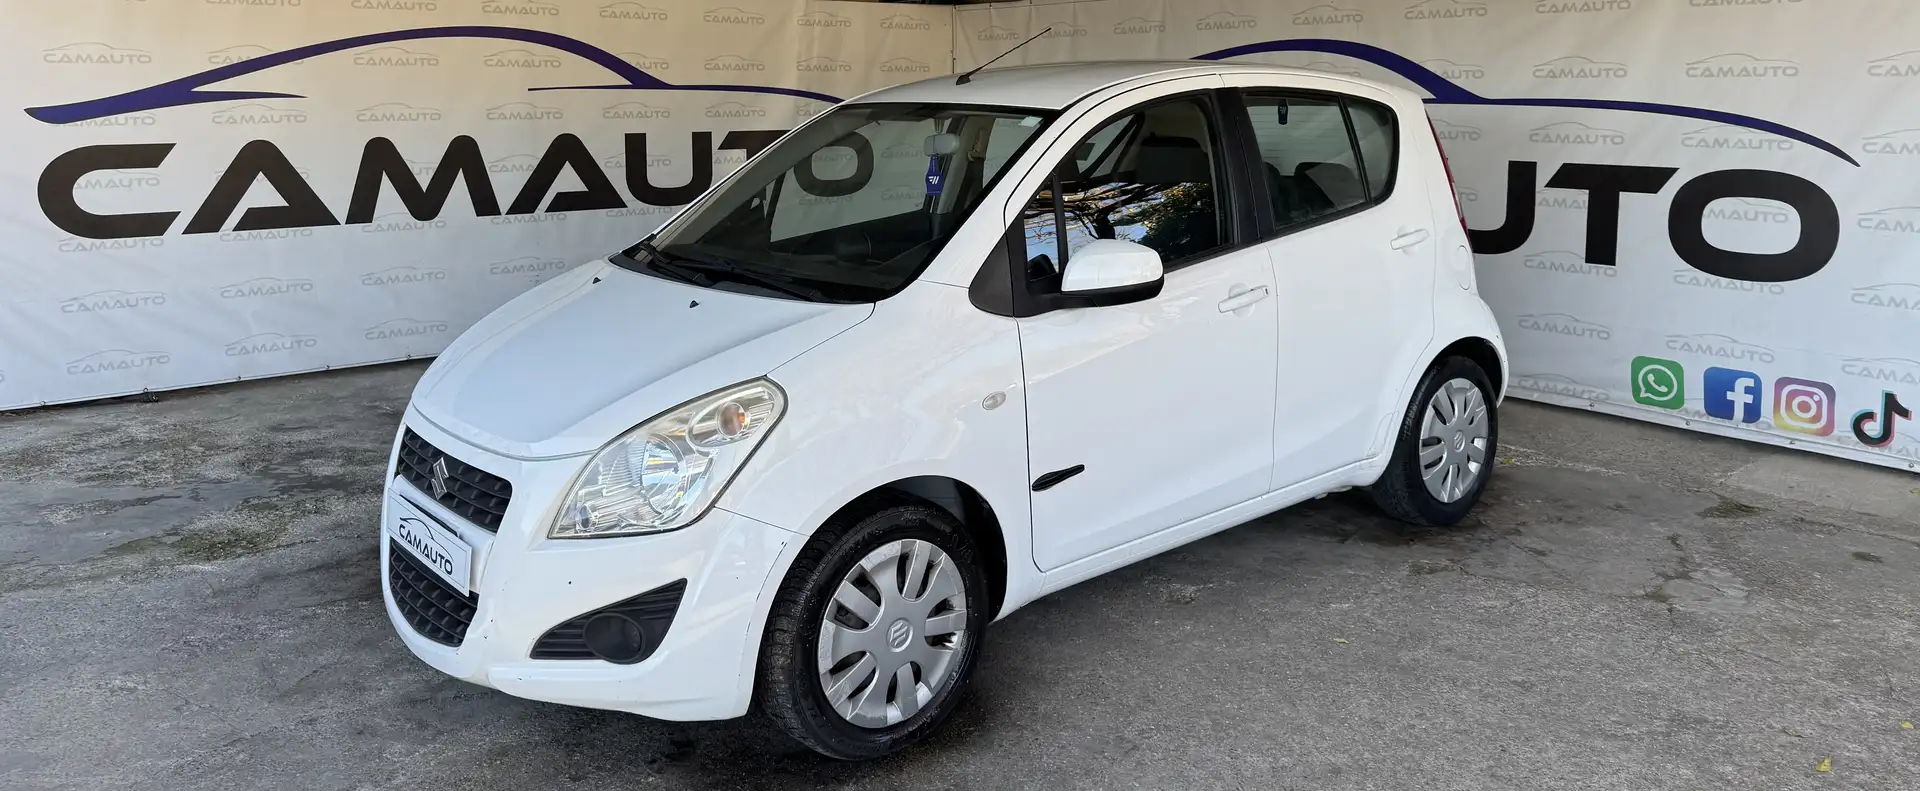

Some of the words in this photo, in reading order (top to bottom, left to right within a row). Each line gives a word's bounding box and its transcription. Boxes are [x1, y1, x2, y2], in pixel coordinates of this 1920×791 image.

[351, 0, 438, 11] CAMAUTO
[481, 3, 560, 16] CAMAUTO
[1536, 0, 1631, 14] CAMAUTO
[599, 8, 668, 21] CAMAUTO
[1404, 7, 1488, 18] CAMAUTO
[703, 14, 765, 26] CAMAUTO
[797, 18, 852, 28] CAMAUTO
[880, 20, 931, 31] CAMAUTO
[1196, 18, 1257, 30] CAMAUTO
[1293, 14, 1364, 26] CAMAUTO
[1114, 24, 1166, 35] CAMAUTO
[978, 32, 1020, 41] CAMAUTO
[43, 52, 152, 65] CAMAUTO
[353, 55, 440, 67] CAMAUTO
[484, 55, 562, 68] CAMAUTO
[634, 60, 670, 70] AUTO
[704, 61, 765, 71] CAMAUTO
[797, 62, 852, 72] CAMAUTO
[880, 63, 931, 73] CAMAUTO
[1533, 65, 1628, 79] CAMAUTO
[1685, 65, 1799, 78] CAMAUTO
[1441, 69, 1485, 80] AUTO
[211, 111, 308, 125] CAMAUTO
[356, 109, 442, 123] CAMAUTO
[486, 107, 564, 120] CAMAUTO
[602, 107, 671, 119] CAMAUTO
[705, 108, 766, 118] CAMAUTO
[1438, 130, 1482, 142] AUTO
[1529, 129, 1625, 146] CAMAUTO
[1681, 136, 1794, 151] CAMAUTO
[74, 177, 160, 190] AMAUTO
[605, 206, 673, 218] CAMAUTO
[1704, 208, 1789, 224] MAUTO
[490, 212, 568, 226] CAMAUTO
[361, 219, 448, 234] CAMAUTO
[219, 228, 314, 243] CAMAUTO
[58, 237, 164, 253] CAMAUTO
[490, 260, 566, 275] CAMAUTO
[1523, 258, 1618, 277] CAMAUTO
[361, 269, 446, 287] CAMAUTO
[1673, 274, 1785, 295] CAMAUTO
[220, 280, 314, 300] CAMAUTO
[61, 293, 166, 314] CAMAUTO
[365, 322, 449, 342] CAMAUTO
[1517, 316, 1611, 341] CAMAUTO
[224, 336, 318, 358] CAMAUTO
[1666, 337, 1776, 365] CAMAUTO
[66, 354, 171, 376] CAMAUTO
[1841, 363, 1920, 385] CAMA
[398, 523, 453, 575] CAMAUTO
